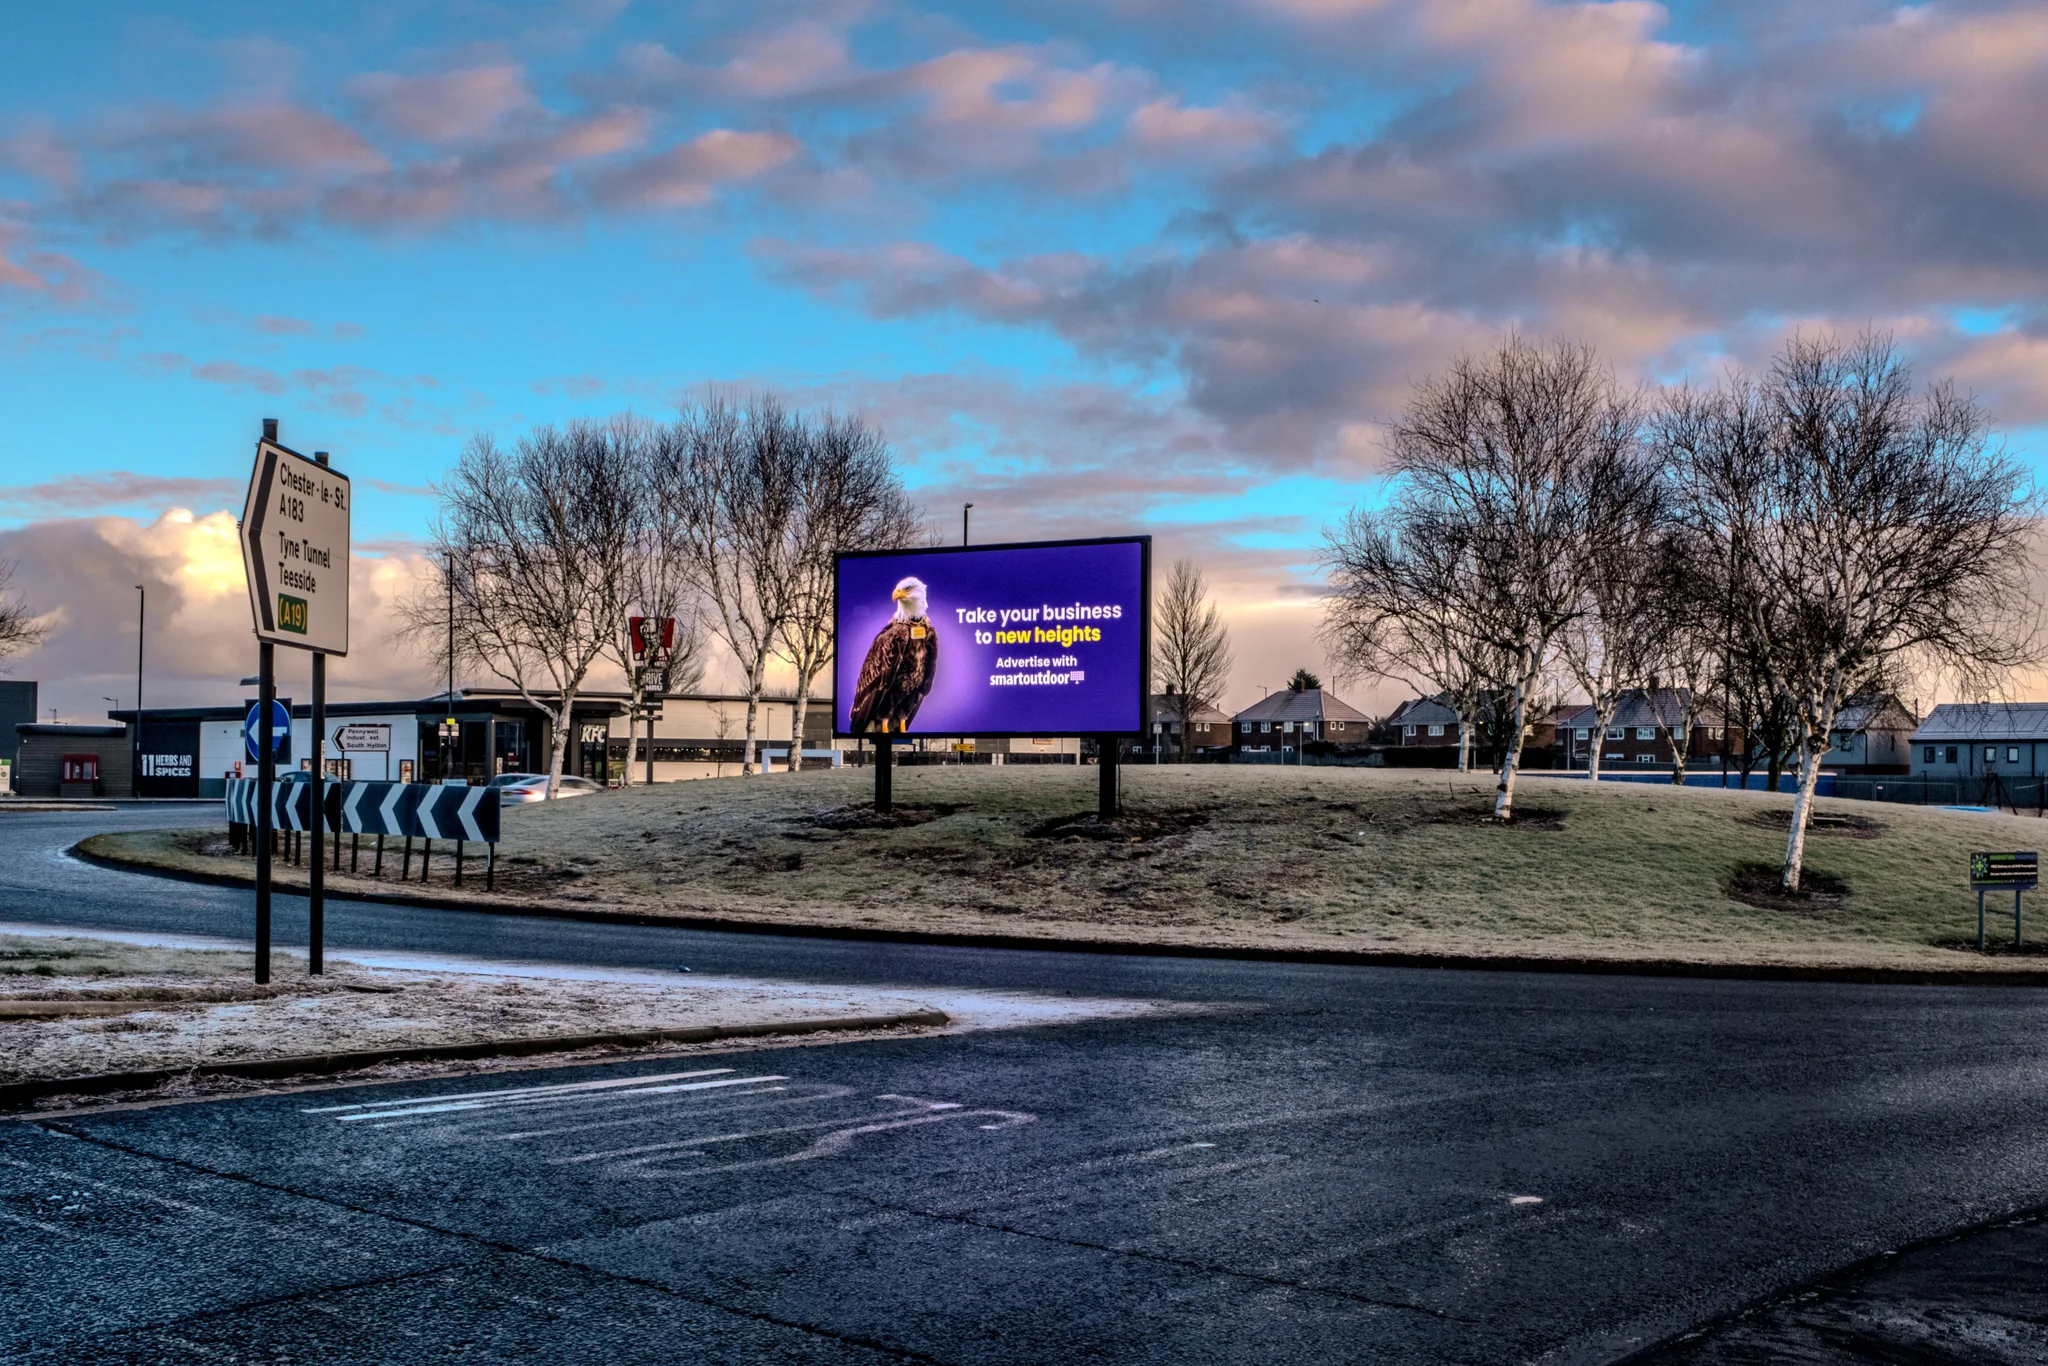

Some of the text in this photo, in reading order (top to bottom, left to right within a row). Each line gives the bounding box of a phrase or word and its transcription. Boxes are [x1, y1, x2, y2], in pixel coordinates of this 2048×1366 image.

[279, 493, 304, 523] A183
[279, 531, 331, 569] Tyne Tunnel
[278, 561, 316, 594] Teesside
[279, 597, 306, 630] (A19)
[956, 602, 1122, 627] Take your business
[975, 625, 1102, 648] to new heights
[996, 655, 1078, 668] Advertise with
[990, 670, 1070, 686] smartoutdoor
[347, 728, 379, 736] Pennywell
[581, 725, 606, 743] KFC
[155, 754, 192, 767] HERBS AND
[155, 767, 192, 777] SPICES
